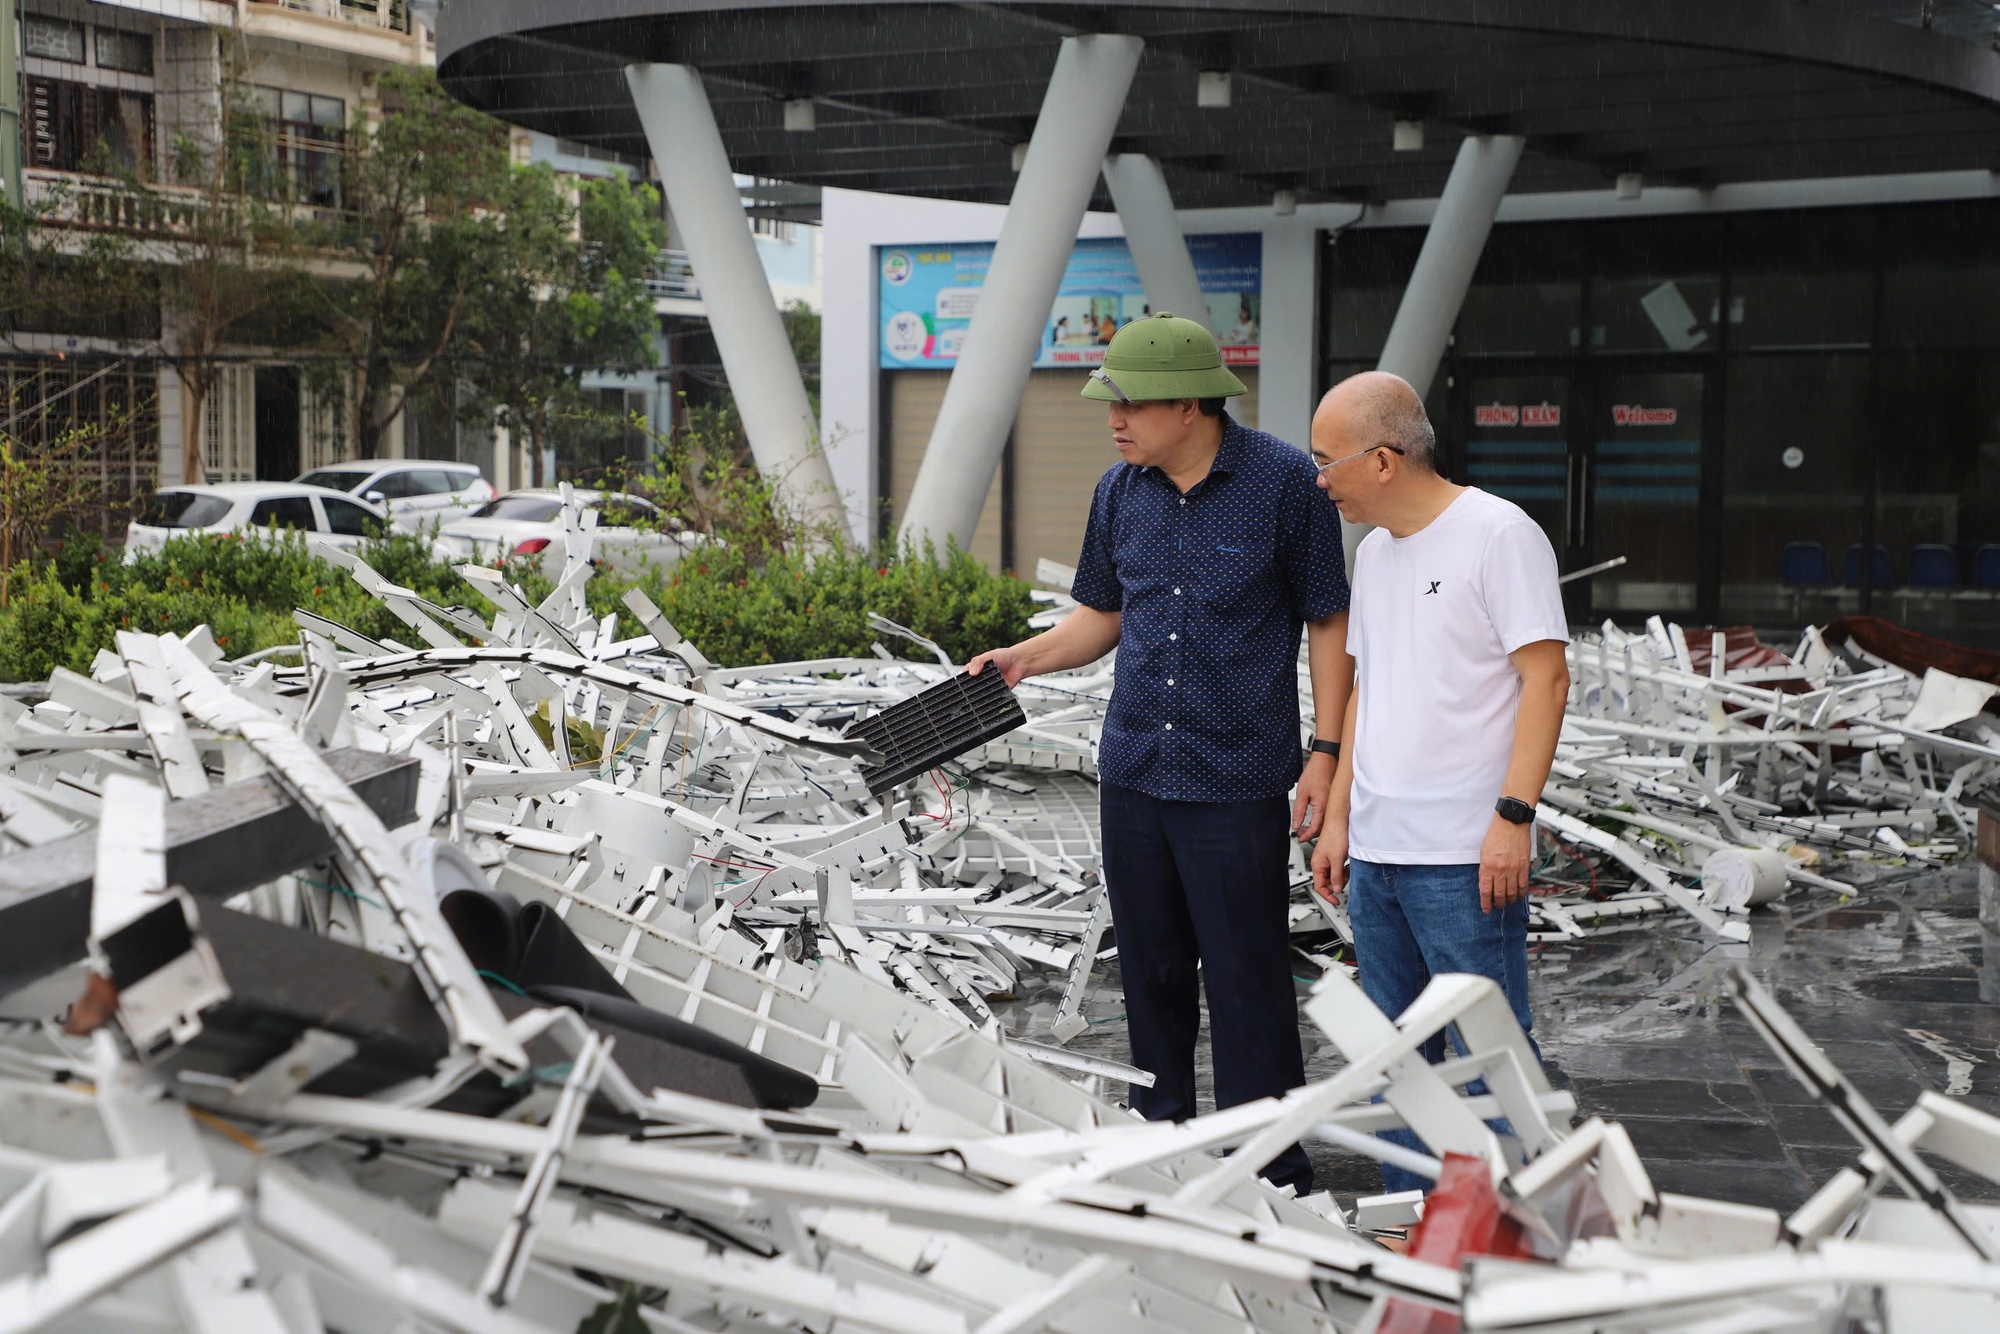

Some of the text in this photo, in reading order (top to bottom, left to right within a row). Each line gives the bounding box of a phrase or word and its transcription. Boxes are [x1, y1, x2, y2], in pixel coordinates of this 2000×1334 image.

[1476, 401, 1560, 426] PHÒNG KHÁM
[1612, 404, 1676, 425] Welcome
